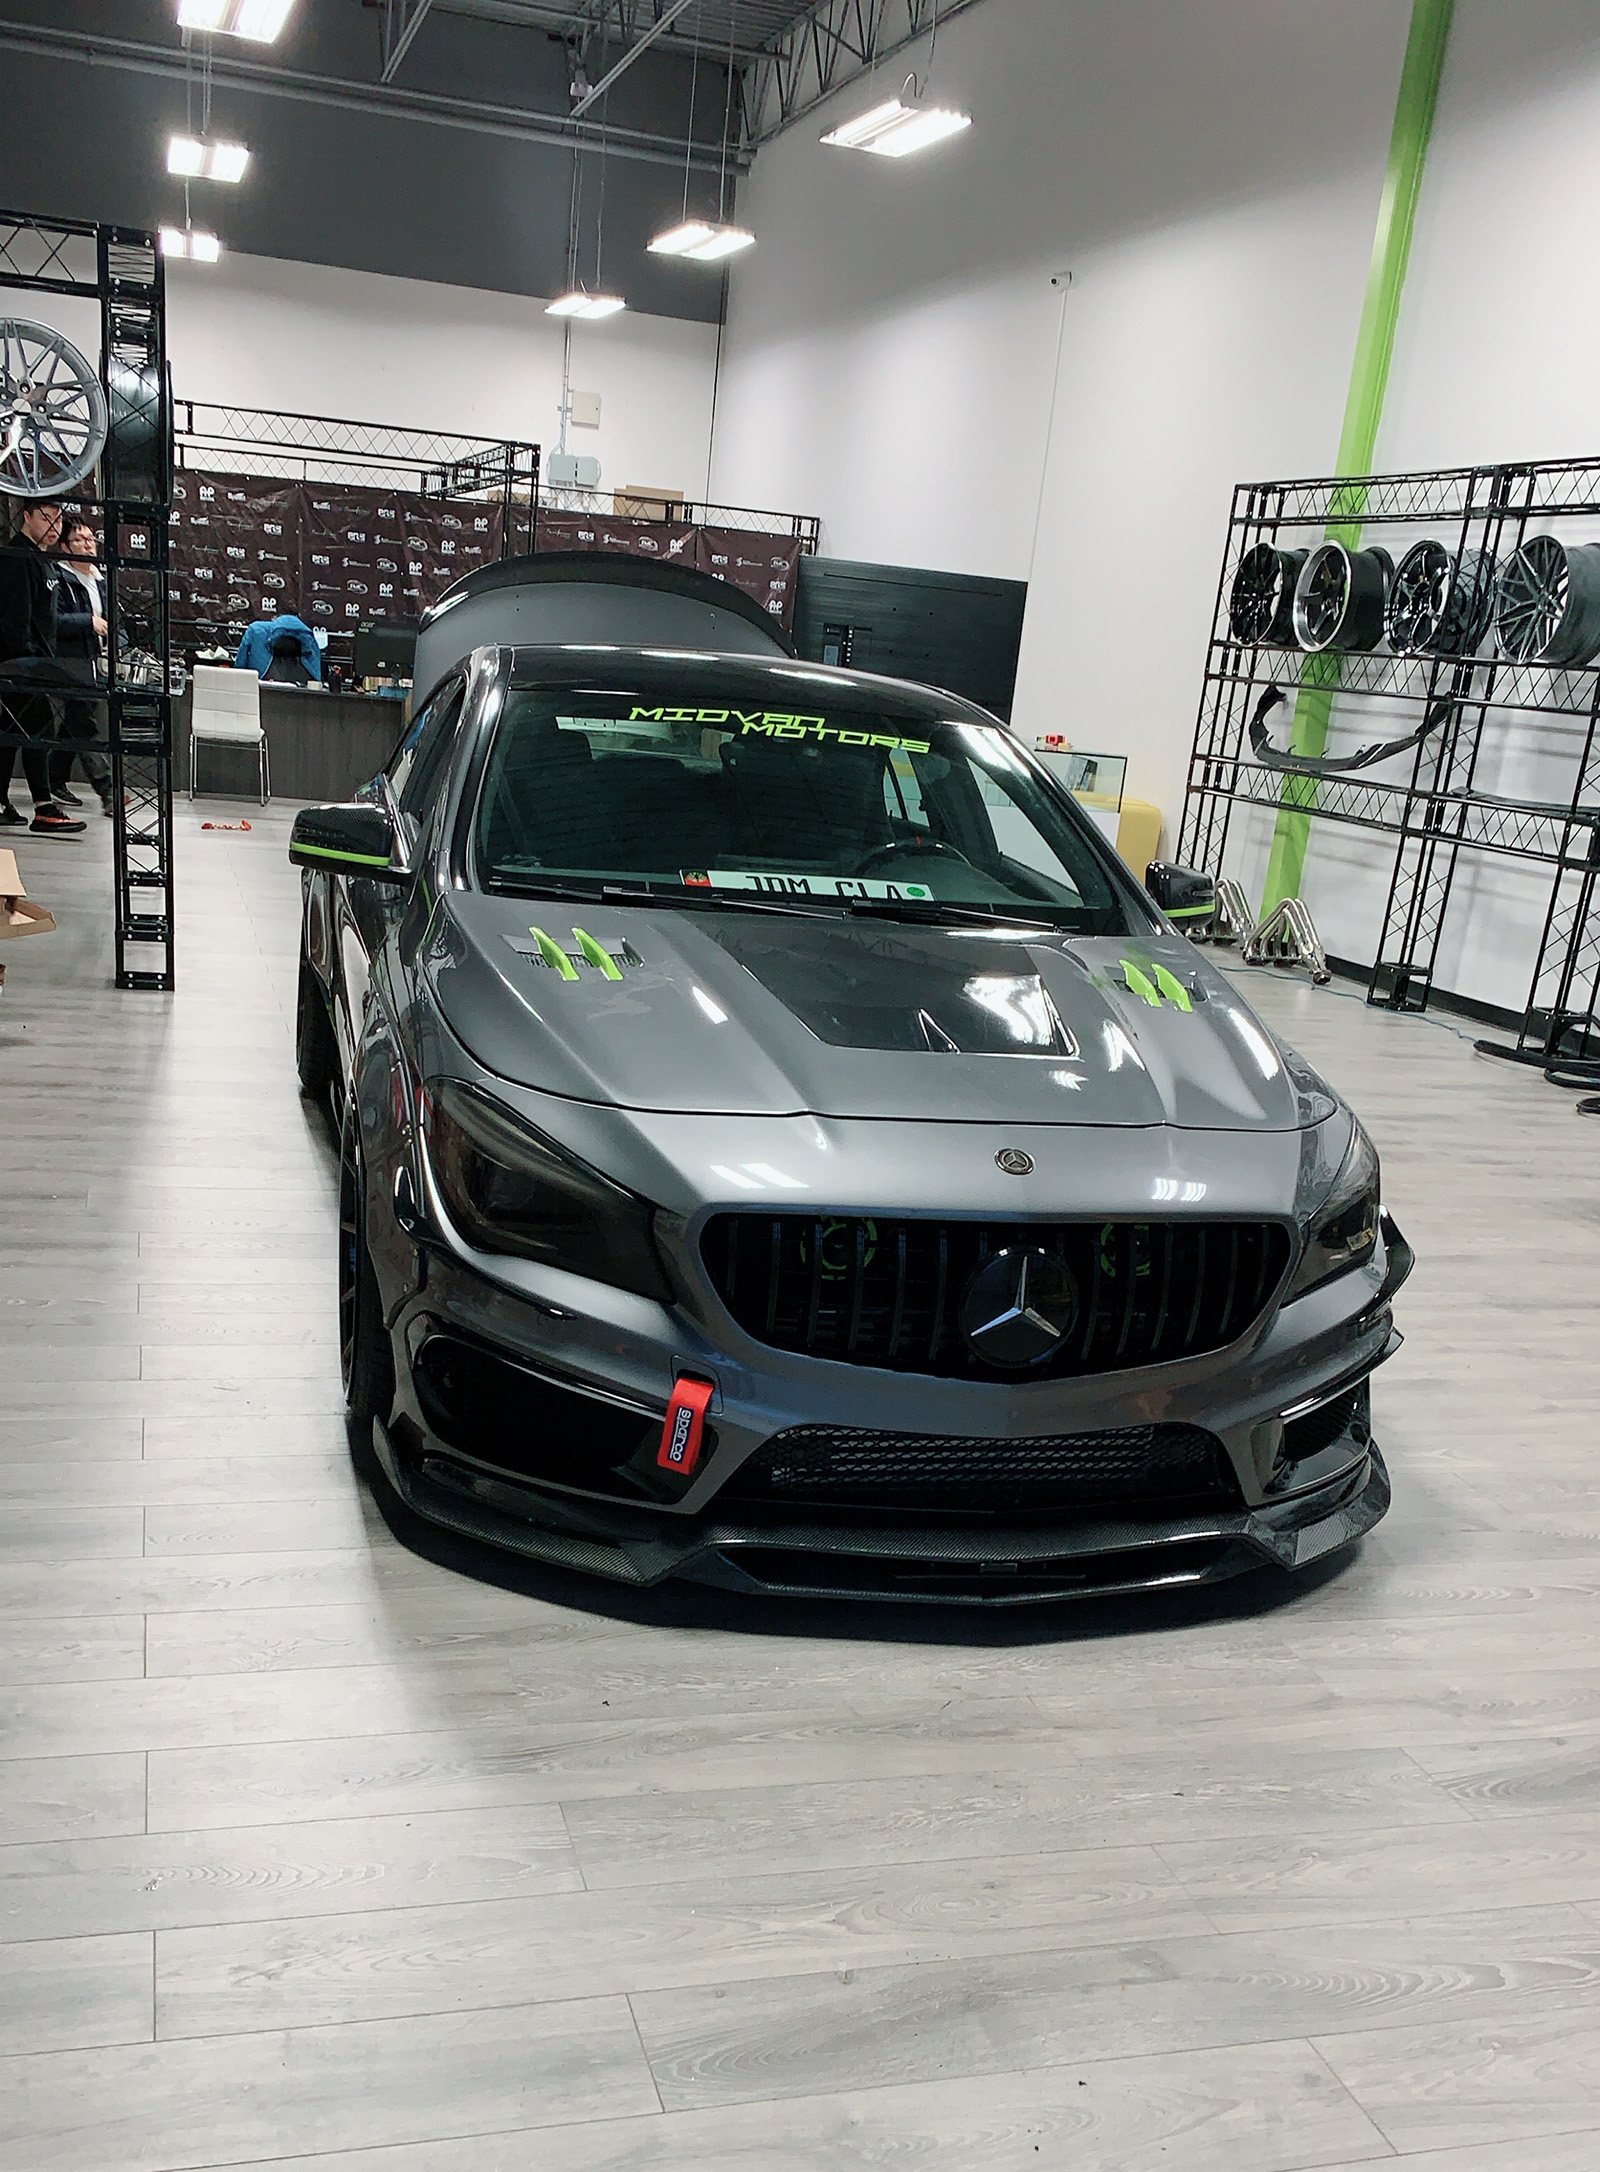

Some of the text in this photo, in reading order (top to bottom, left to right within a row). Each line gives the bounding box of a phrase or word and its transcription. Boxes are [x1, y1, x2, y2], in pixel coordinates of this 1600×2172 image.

[629, 707, 825, 728] MIDYAN
[741, 722, 931, 754] MOTORS
[743, 875, 904, 900] JDM CLA
[672, 1407, 692, 1461] sparco
